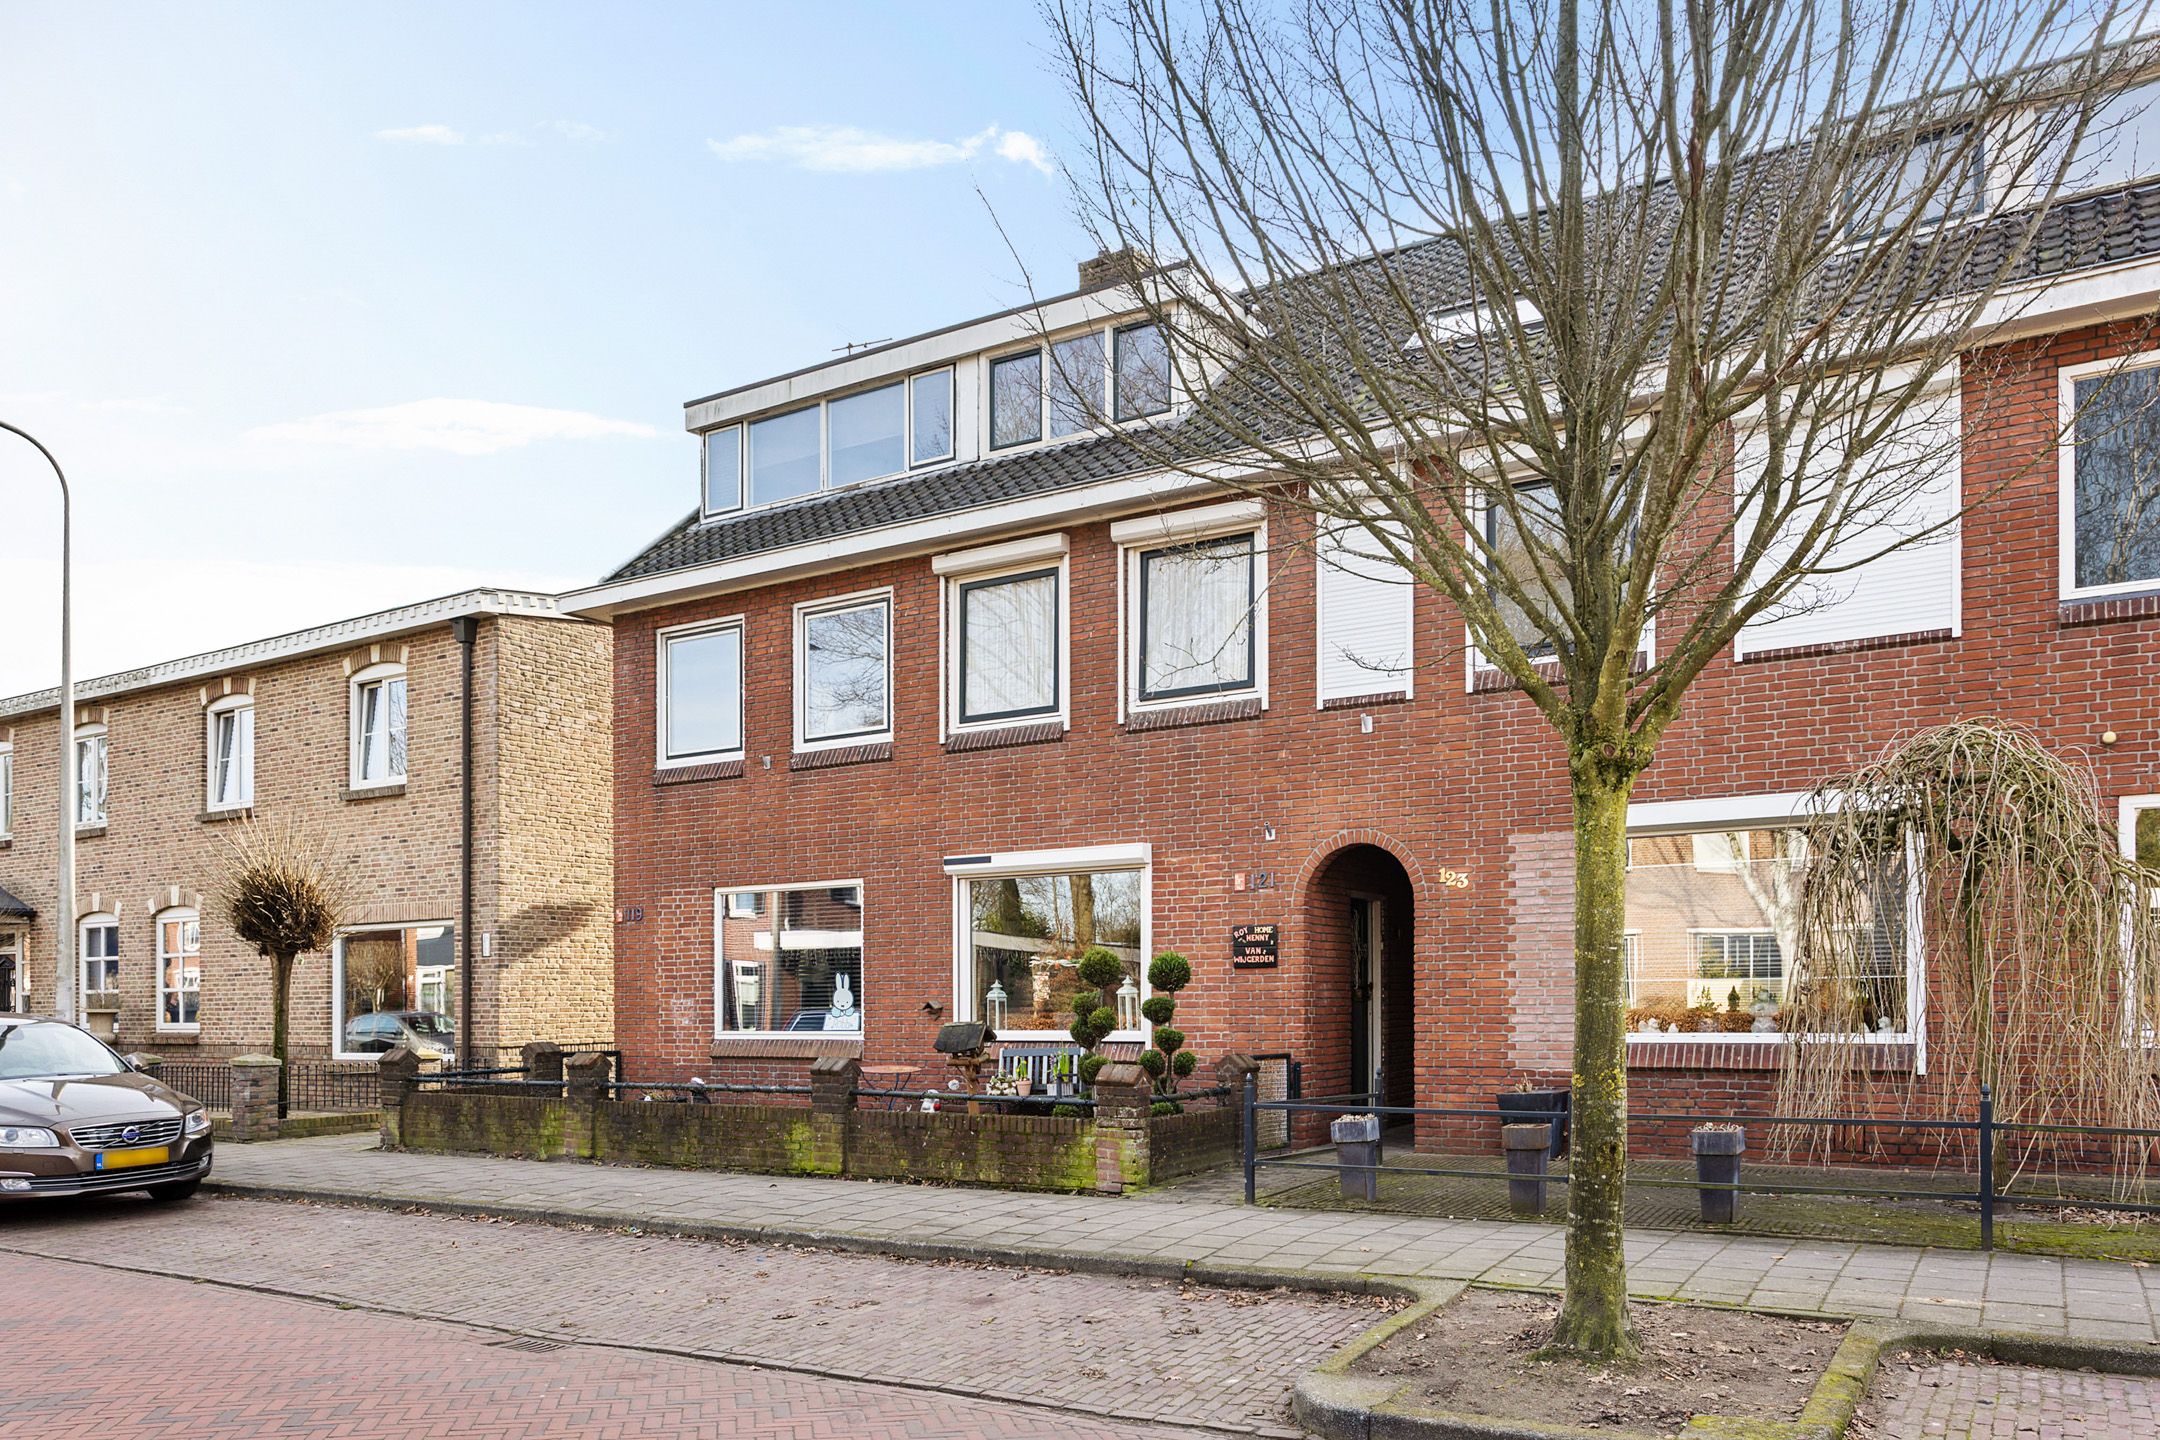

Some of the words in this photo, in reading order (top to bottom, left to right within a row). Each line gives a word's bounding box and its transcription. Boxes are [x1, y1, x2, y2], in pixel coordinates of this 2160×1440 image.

[1250, 872, 1275, 890] 121
[1438, 867, 1469, 889] 123
[624, 907, 643, 922] 119
[1234, 926, 1248, 938] ROY
[1254, 926, 1274, 934] HOME
[1246, 934, 1269, 942] HENNY
[1245, 947, 1262, 955] VAN
